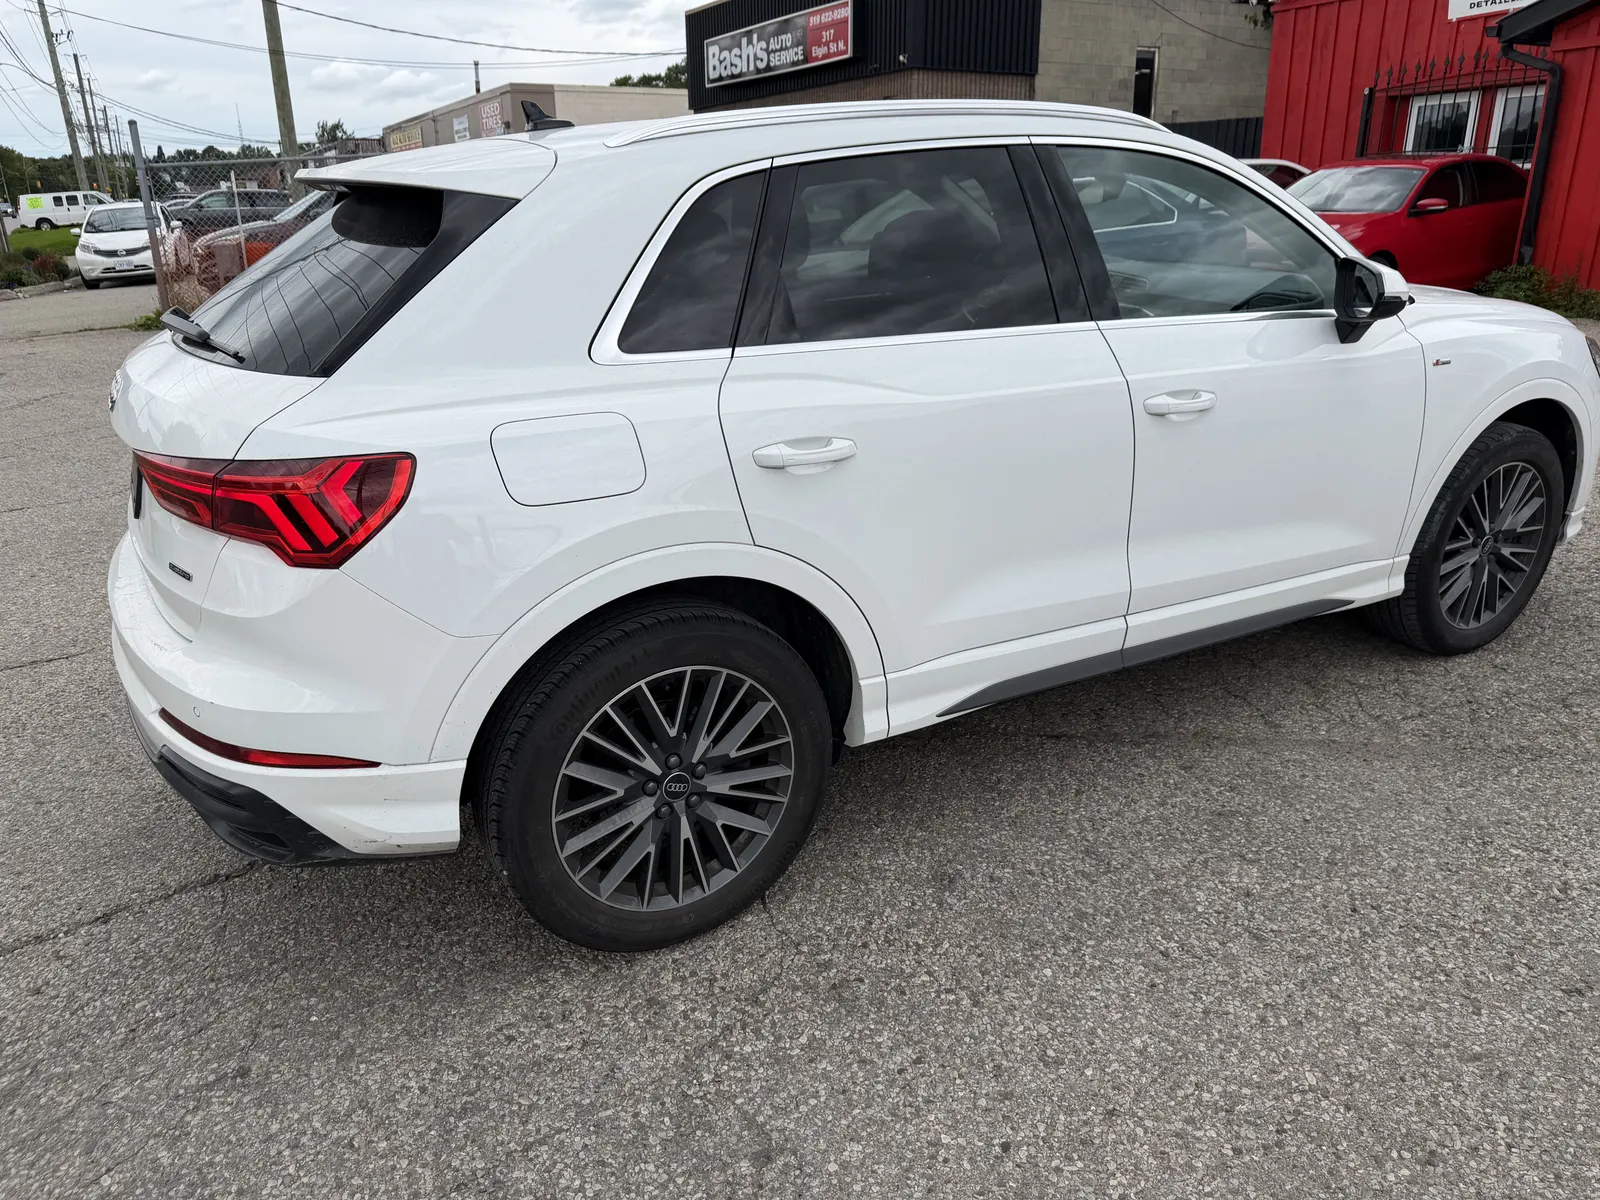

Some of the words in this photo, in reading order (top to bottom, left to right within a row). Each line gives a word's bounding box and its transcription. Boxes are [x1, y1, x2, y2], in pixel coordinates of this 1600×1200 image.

[1470, 0, 1520, 9] DETAIL
[809, 14, 821, 27] 519
[821, 7, 849, 24] 622-9280
[769, 33, 792, 51] AUTO
[822, 29, 834, 42] 317
[708, 33, 768, 80] Bash's
[769, 46, 803, 67] SERVICE
[812, 44, 828, 58] Elgin
[829, 41, 837, 53] St
[838, 40, 846, 51] N.
[481, 102, 500, 118] USED
[482, 115, 502, 130] TIRES
